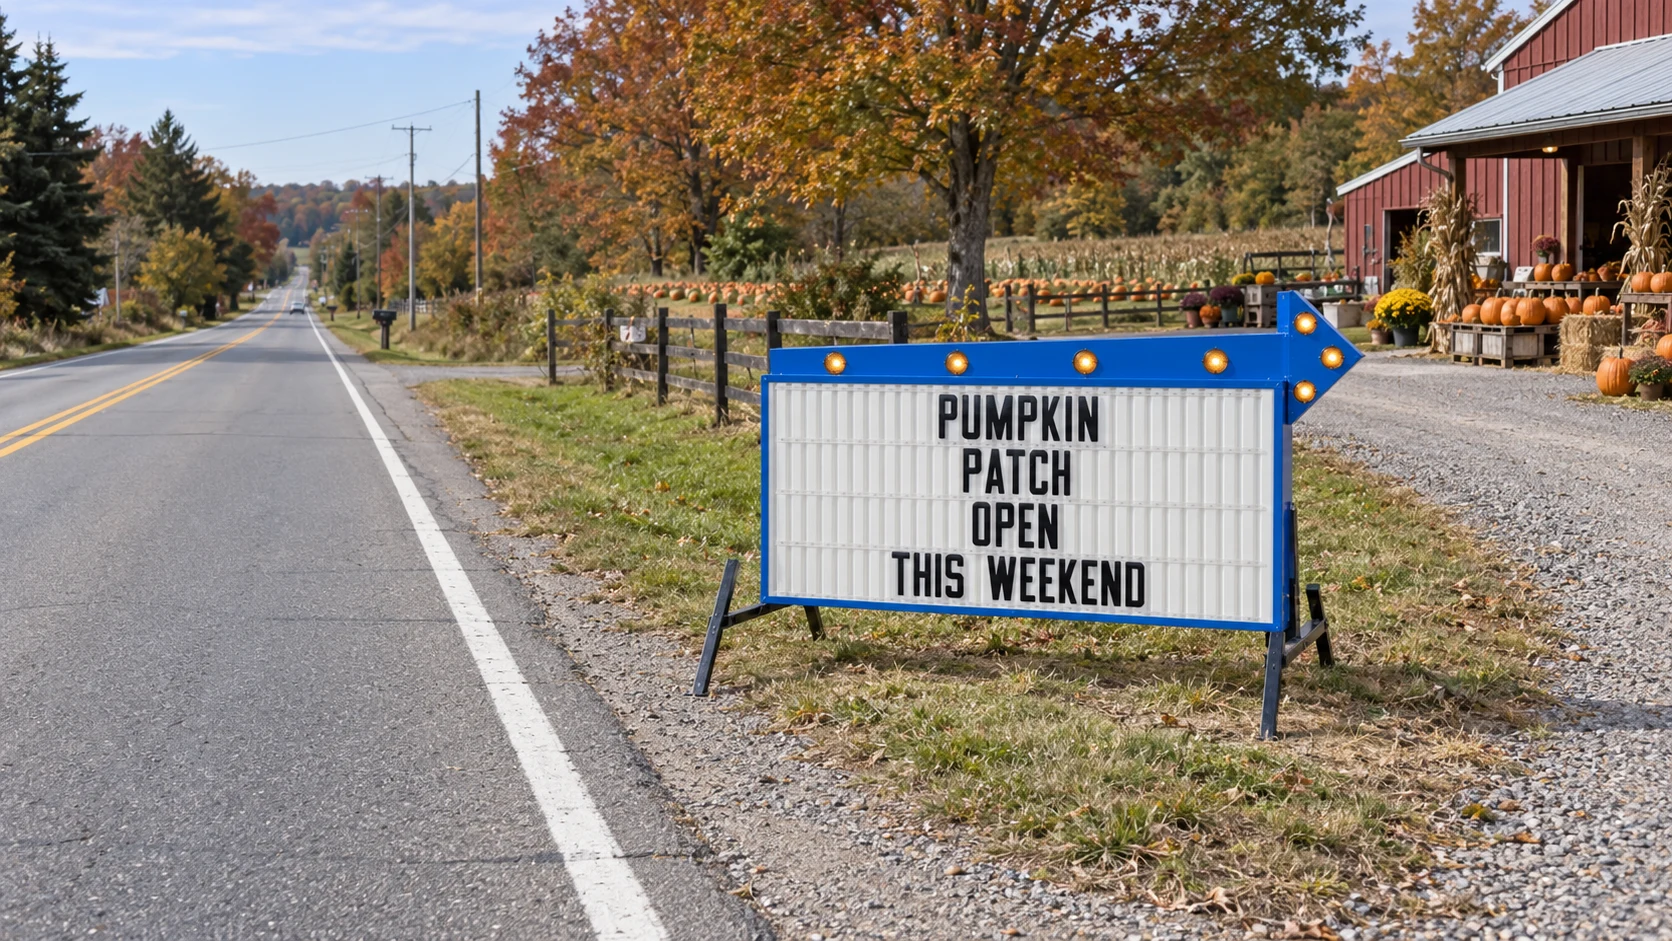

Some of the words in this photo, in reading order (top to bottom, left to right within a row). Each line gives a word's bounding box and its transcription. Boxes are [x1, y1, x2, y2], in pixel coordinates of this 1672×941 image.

[938, 394, 1099, 442] PUMPKIN
[962, 447, 1071, 496] PATCH
[972, 501, 1059, 549] OPEN
[891, 551, 965, 598] THIS
[987, 555, 1145, 607] WEEKEND
